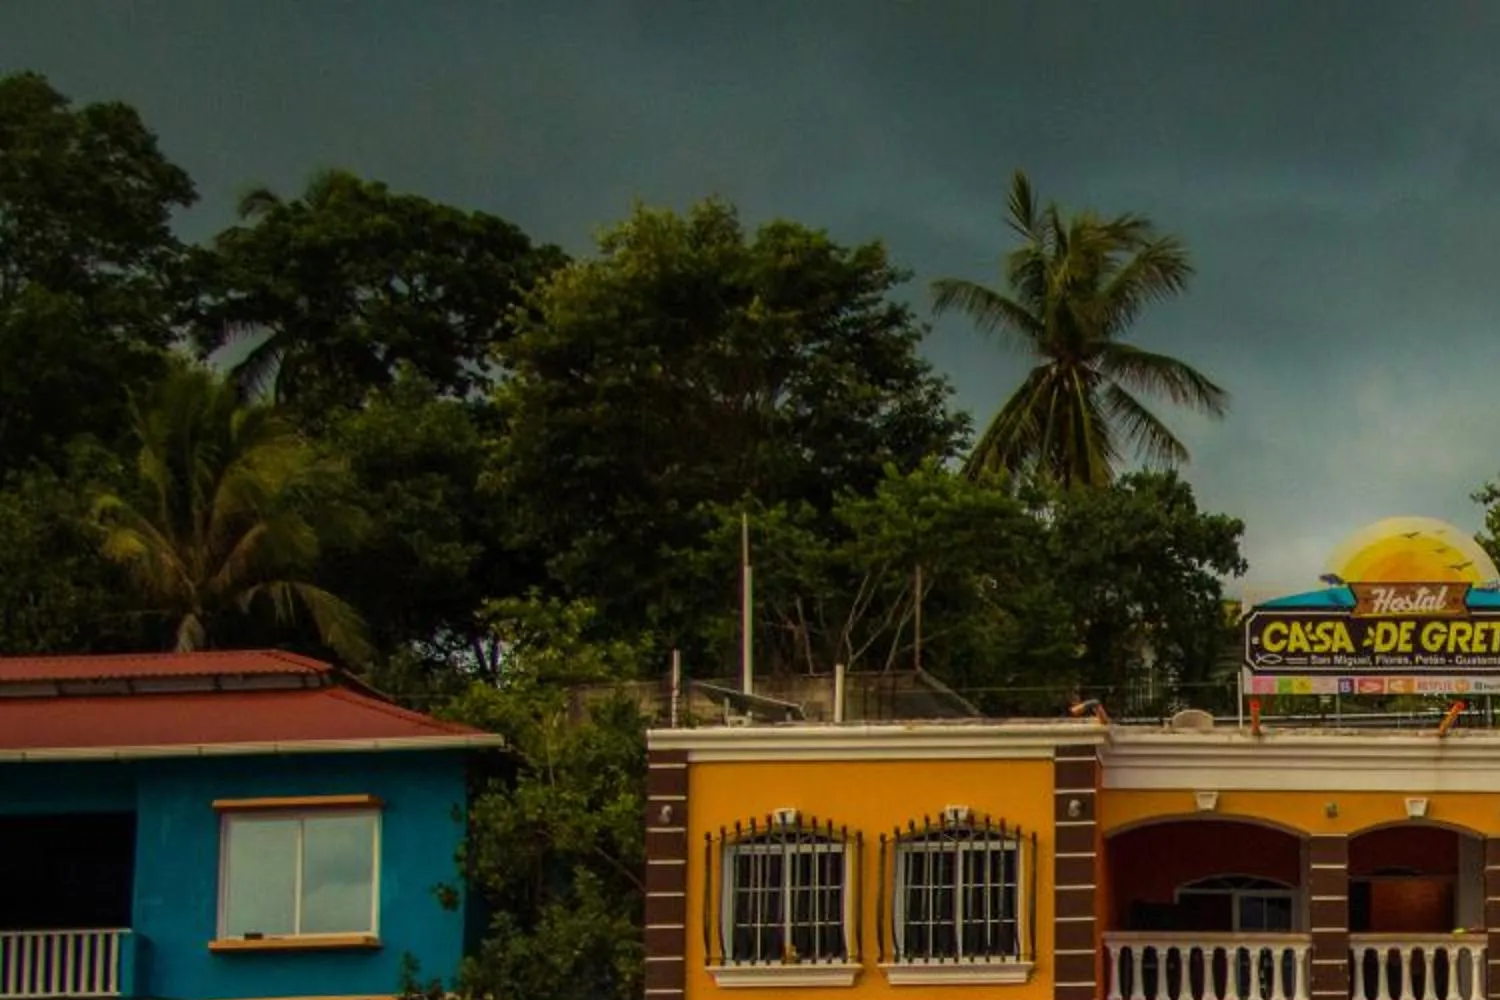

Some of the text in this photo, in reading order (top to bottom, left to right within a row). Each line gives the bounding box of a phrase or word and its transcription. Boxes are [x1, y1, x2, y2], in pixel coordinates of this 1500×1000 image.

[1371, 585, 1449, 613] Hostal
[1262, 621, 1356, 653] CASA
[1374, 621, 1416, 653] DE
[1310, 654, 1331, 665] San
